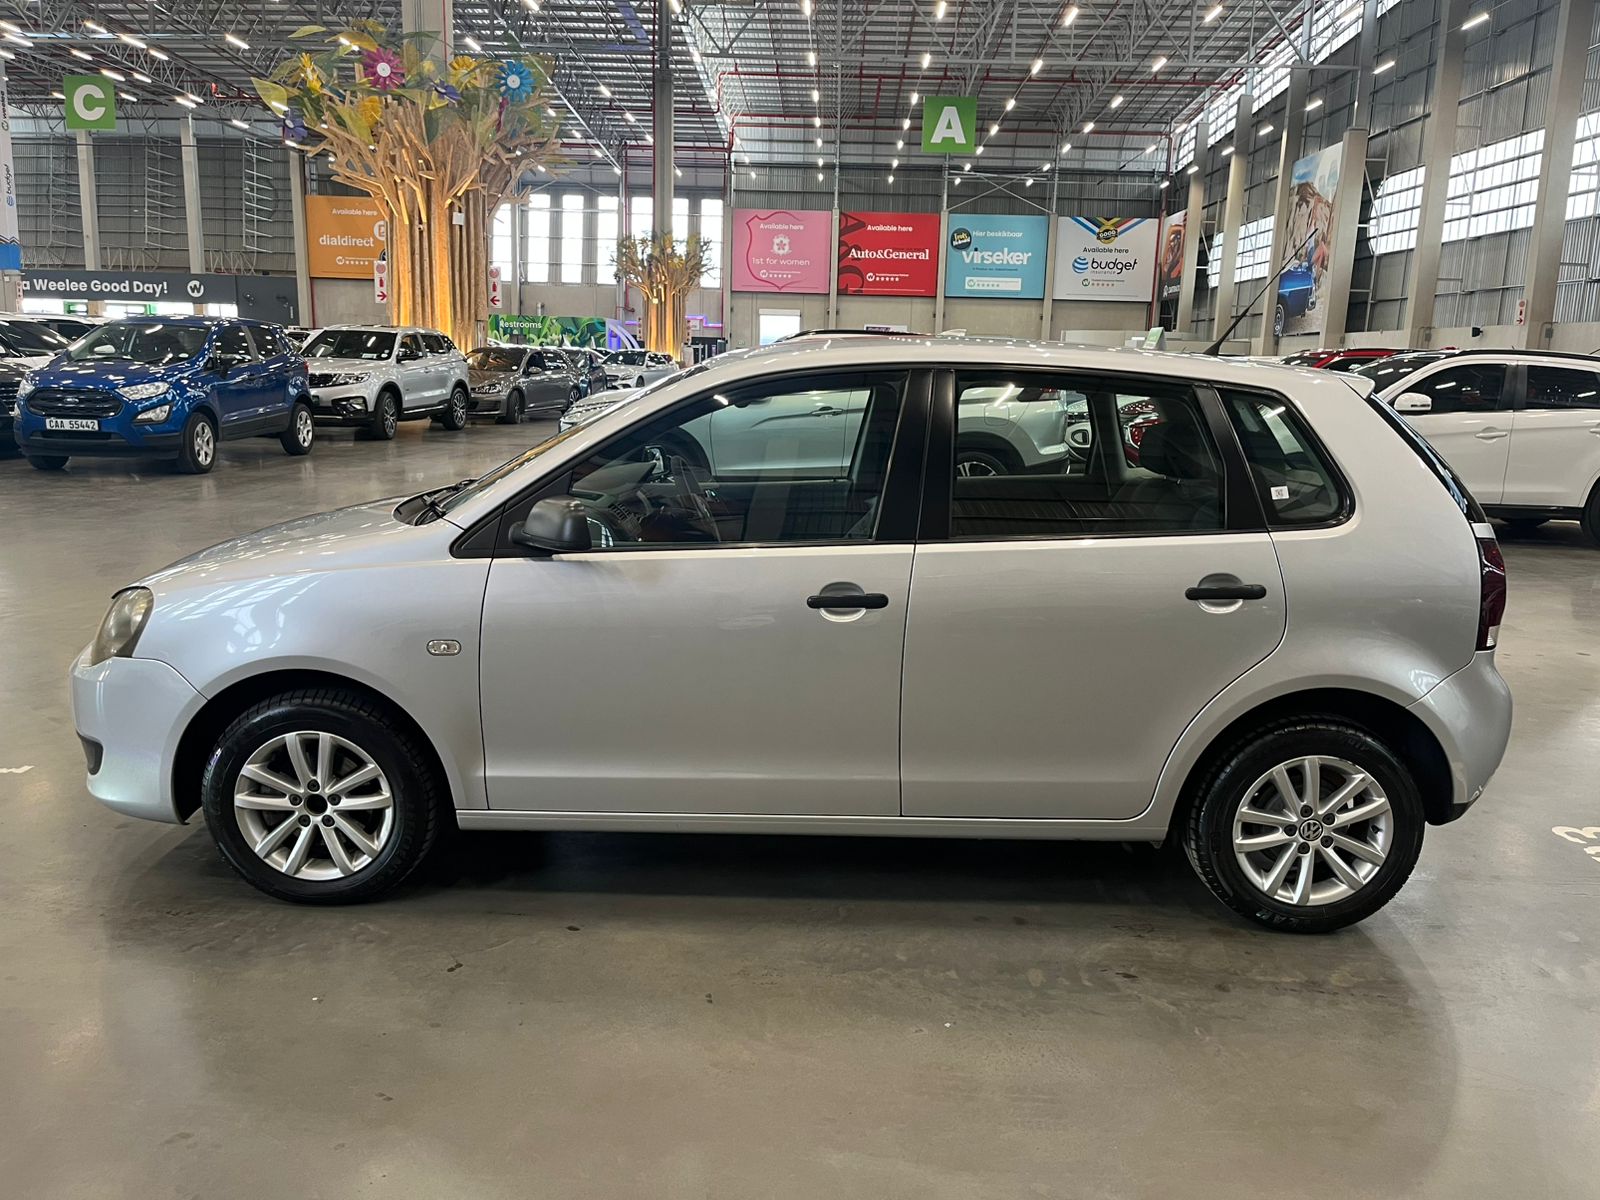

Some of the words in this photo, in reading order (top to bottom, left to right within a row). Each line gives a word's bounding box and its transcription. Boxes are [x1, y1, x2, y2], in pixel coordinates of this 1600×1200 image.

[73, 84, 106, 121] C
[930, 106, 966, 144] A
[4, 164, 13, 195] budget
[332, 208, 362, 216] Available
[867, 224, 897, 232] Available
[986, 230, 1023, 238] beskikbaar
[319, 234, 374, 247] dialdirect
[848, 248, 929, 260] Auto&General
[961, 247, 1032, 265] virseker
[1083, 246, 1114, 254] Available
[752, 257, 764, 265] 1st
[766, 257, 778, 265] for
[780, 258, 810, 266] women
[1091, 257, 1138, 275] budget
[22, 281, 31, 291] a
[33, 278, 87, 292] Weelee
[90, 279, 130, 293] Good
[133, 280, 168, 297] Day!
[499, 319, 543, 329] Restrooms
[49, 420, 65, 429] CAA
[69, 420, 96, 430] 55442
